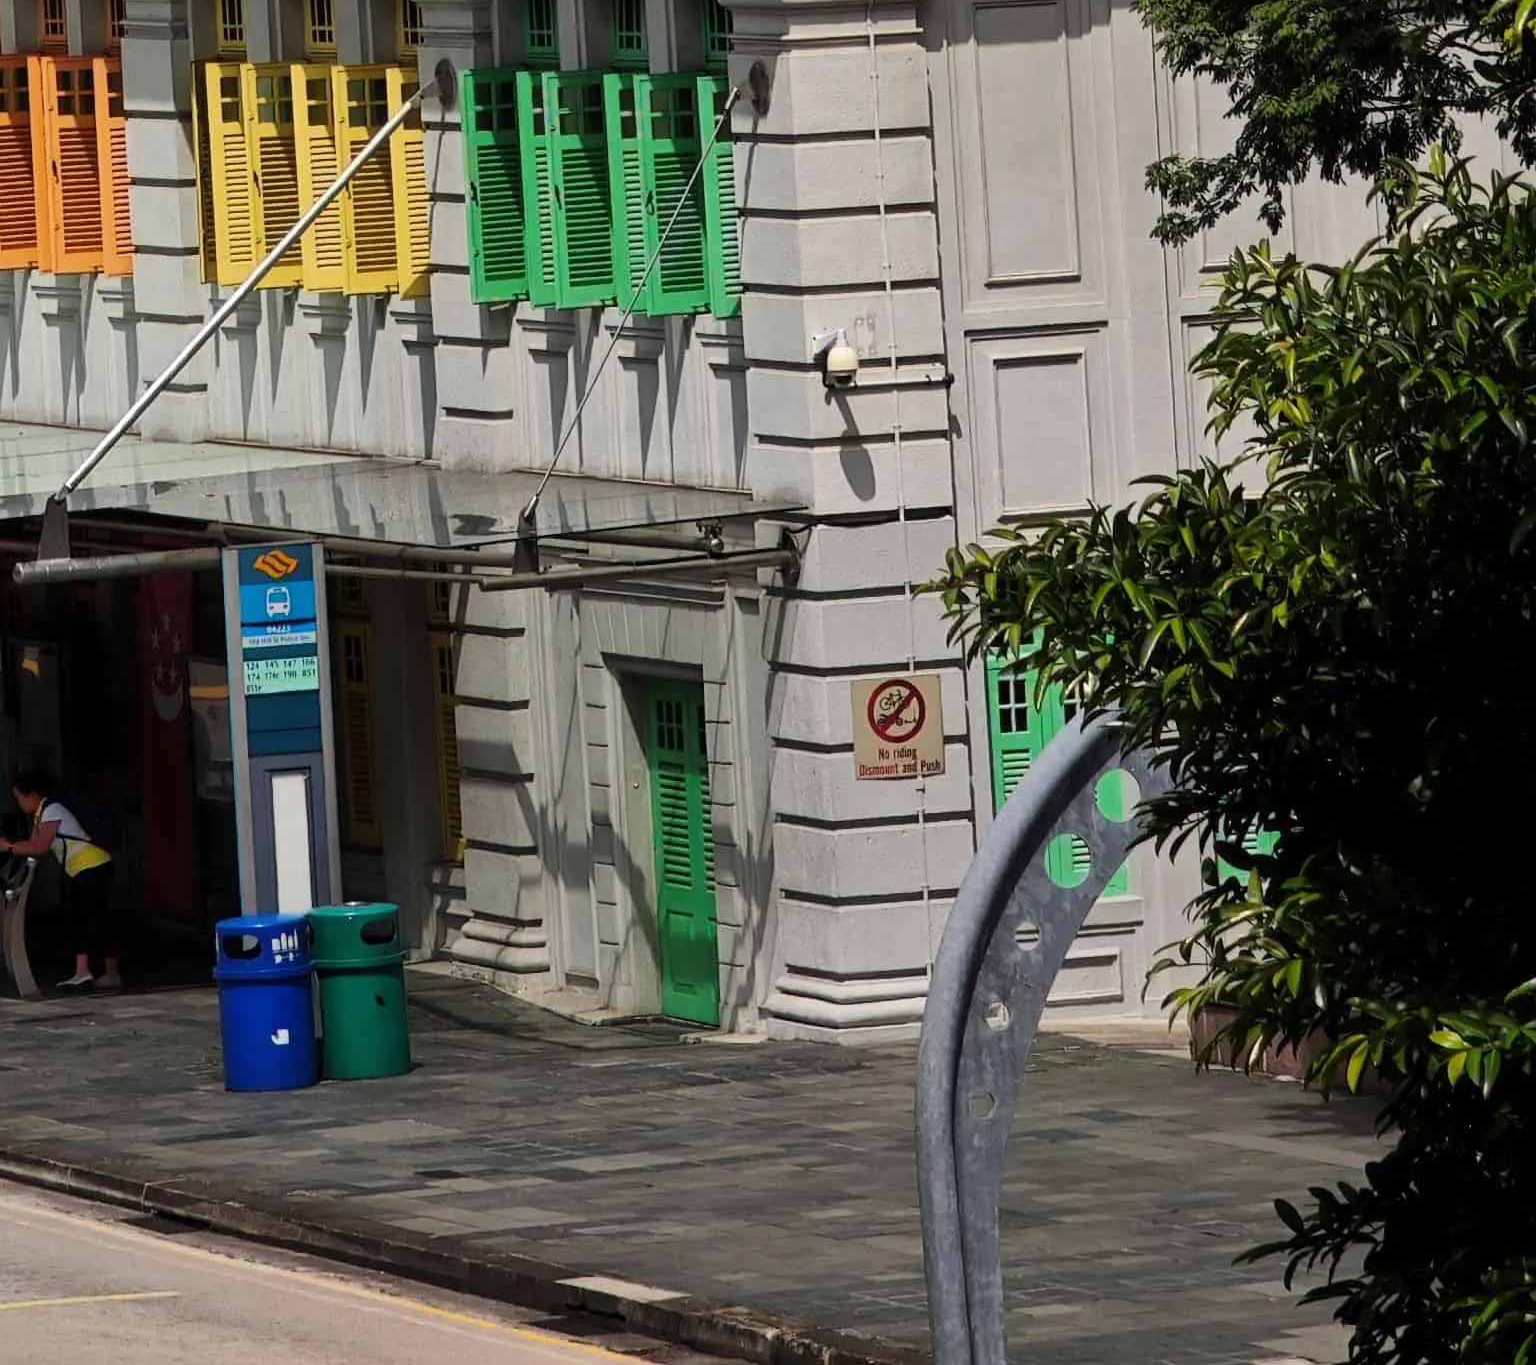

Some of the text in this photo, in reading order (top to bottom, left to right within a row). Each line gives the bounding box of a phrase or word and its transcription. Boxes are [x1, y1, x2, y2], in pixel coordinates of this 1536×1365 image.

[878, 746, 918, 760] No riding
[859, 758, 941, 776] Dismount and Push
